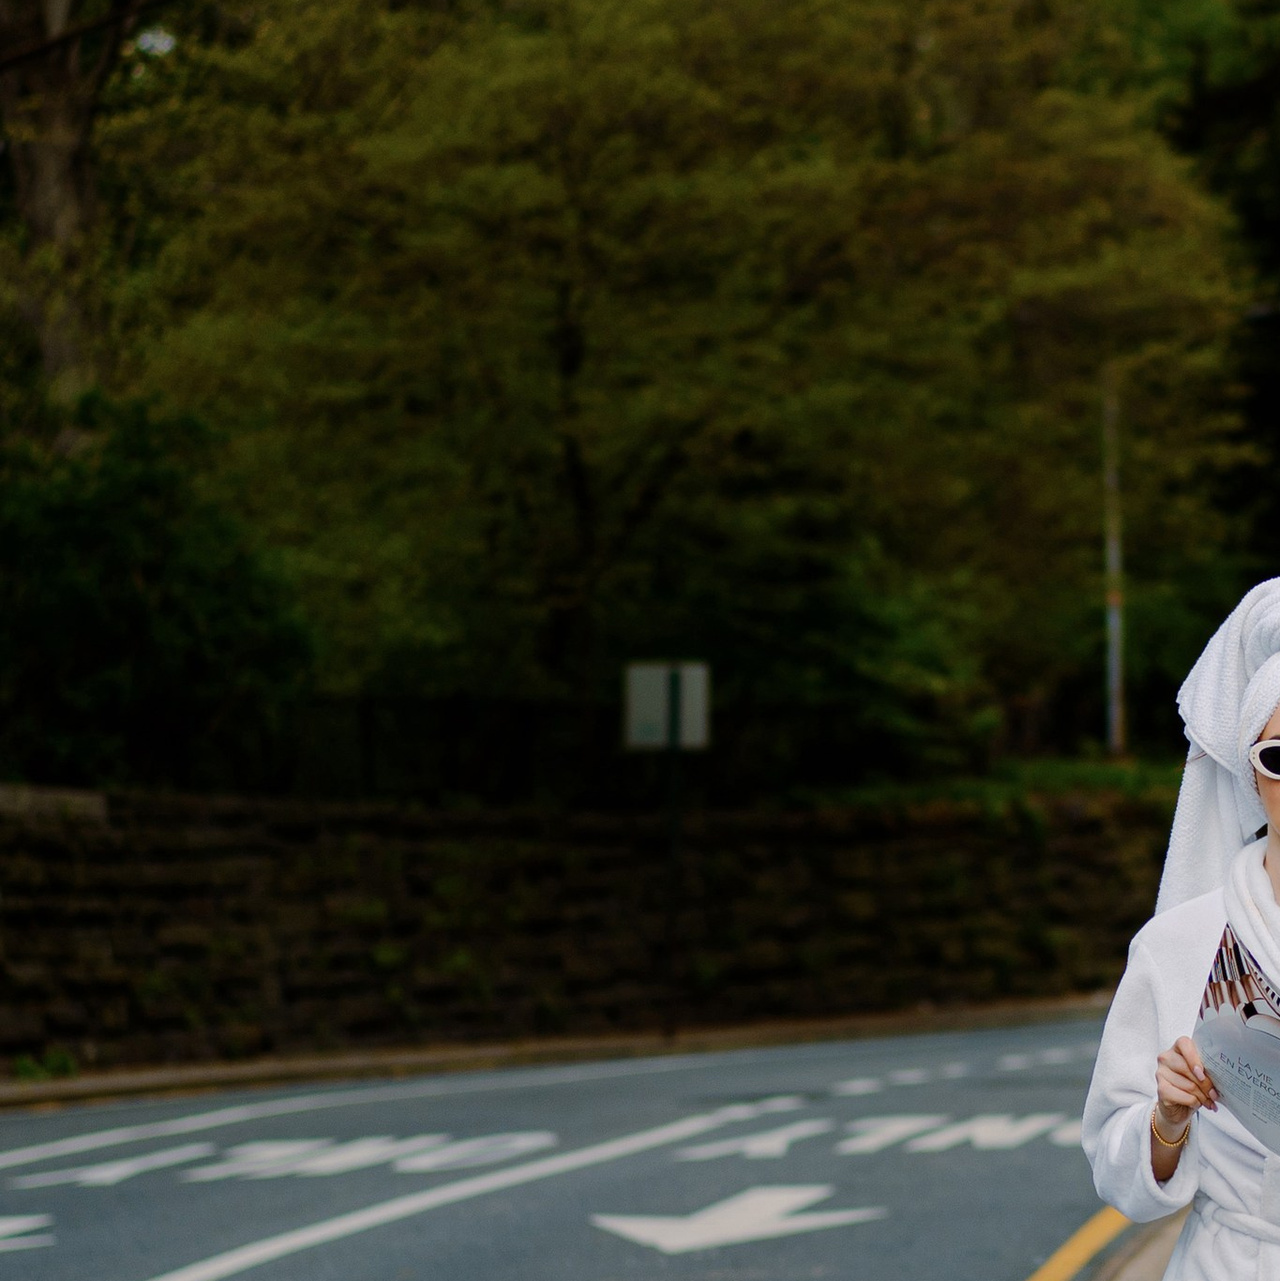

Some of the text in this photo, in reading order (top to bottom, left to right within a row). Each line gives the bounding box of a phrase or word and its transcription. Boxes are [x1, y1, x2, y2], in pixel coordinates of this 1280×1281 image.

[1220, 1052, 1235, 1069] EN
[1238, 1057, 1273, 1086] LA VIE
